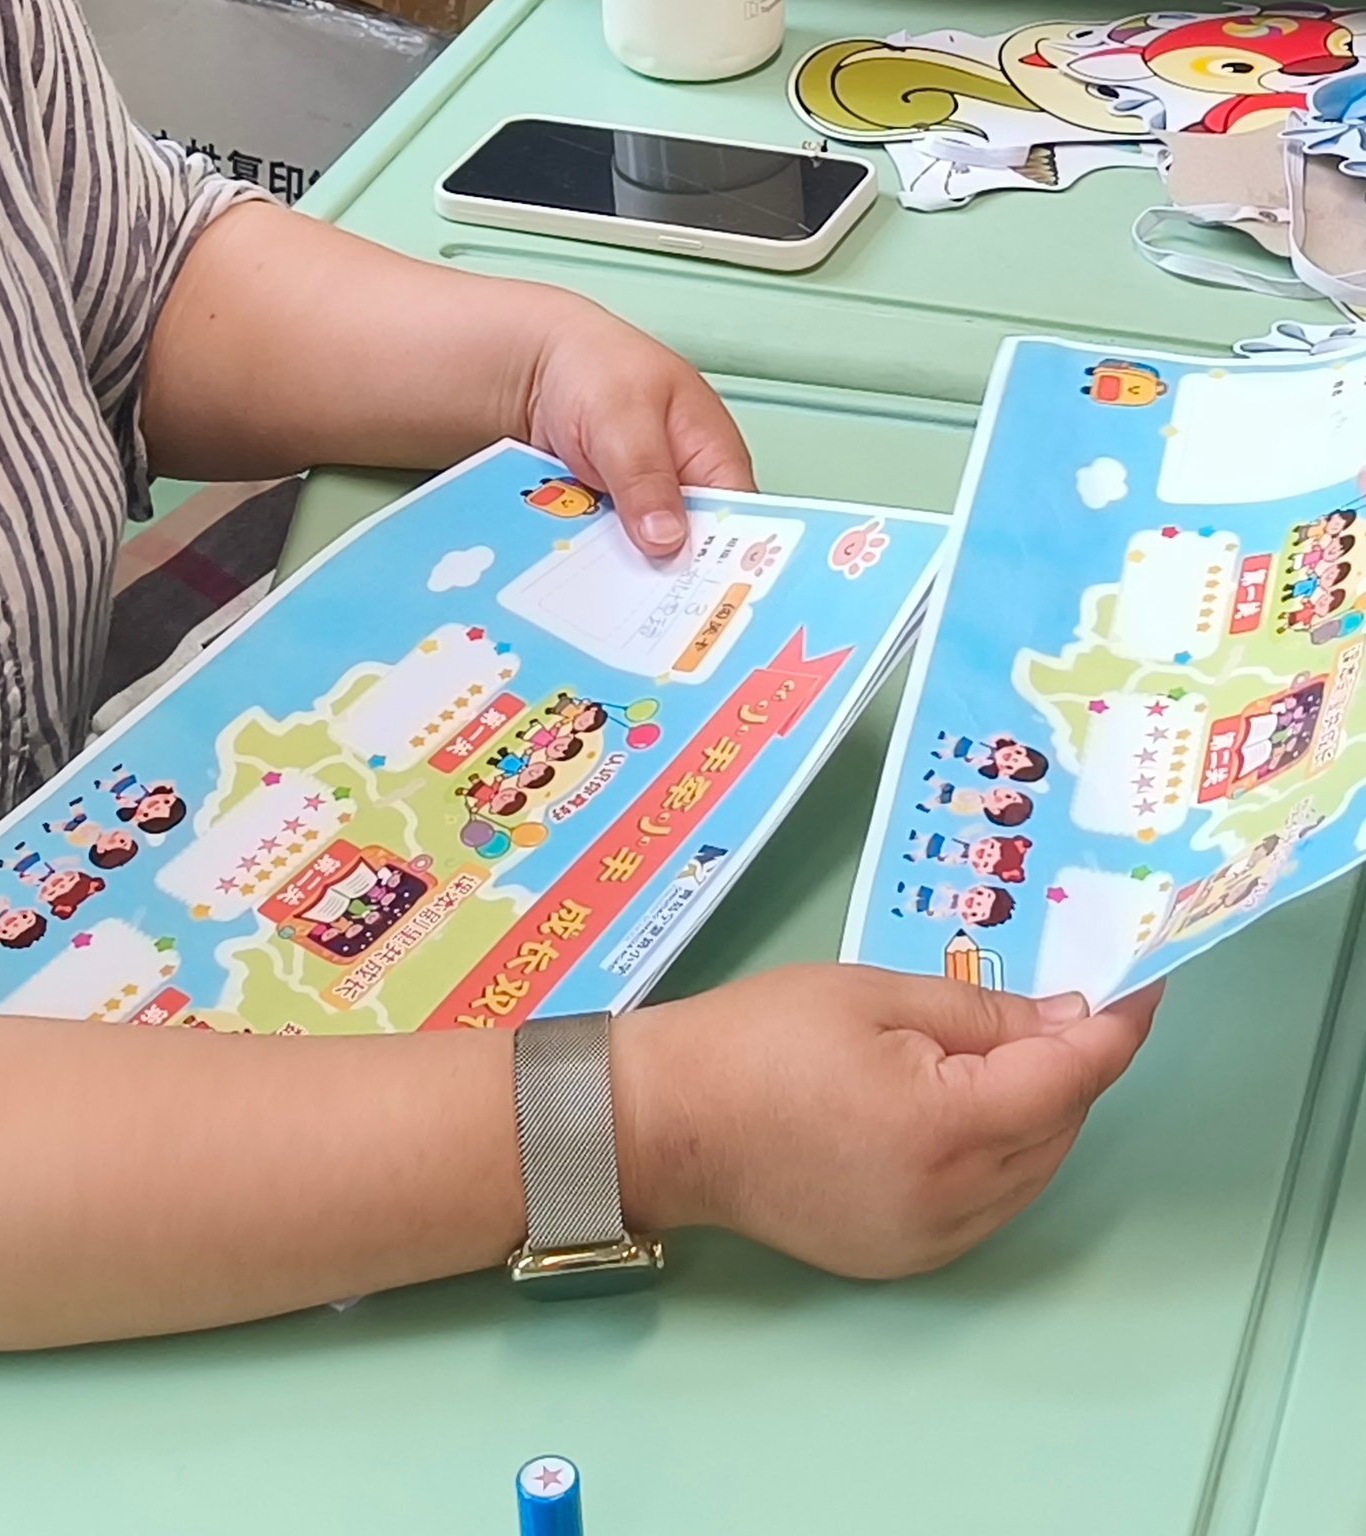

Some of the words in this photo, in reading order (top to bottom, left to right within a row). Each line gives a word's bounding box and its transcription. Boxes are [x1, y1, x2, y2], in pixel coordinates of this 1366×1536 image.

[443, 707, 508, 757] 第一关
[1202, 731, 1235, 787] 第二关
[551, 754, 625, 821] 认识你真好
[586, 680, 798, 888] “小手牵小手
[274, 853, 342, 905] 第二关
[333, 873, 480, 1001] 课本剧里共成长
[133, 1003, 169, 1026] 第
